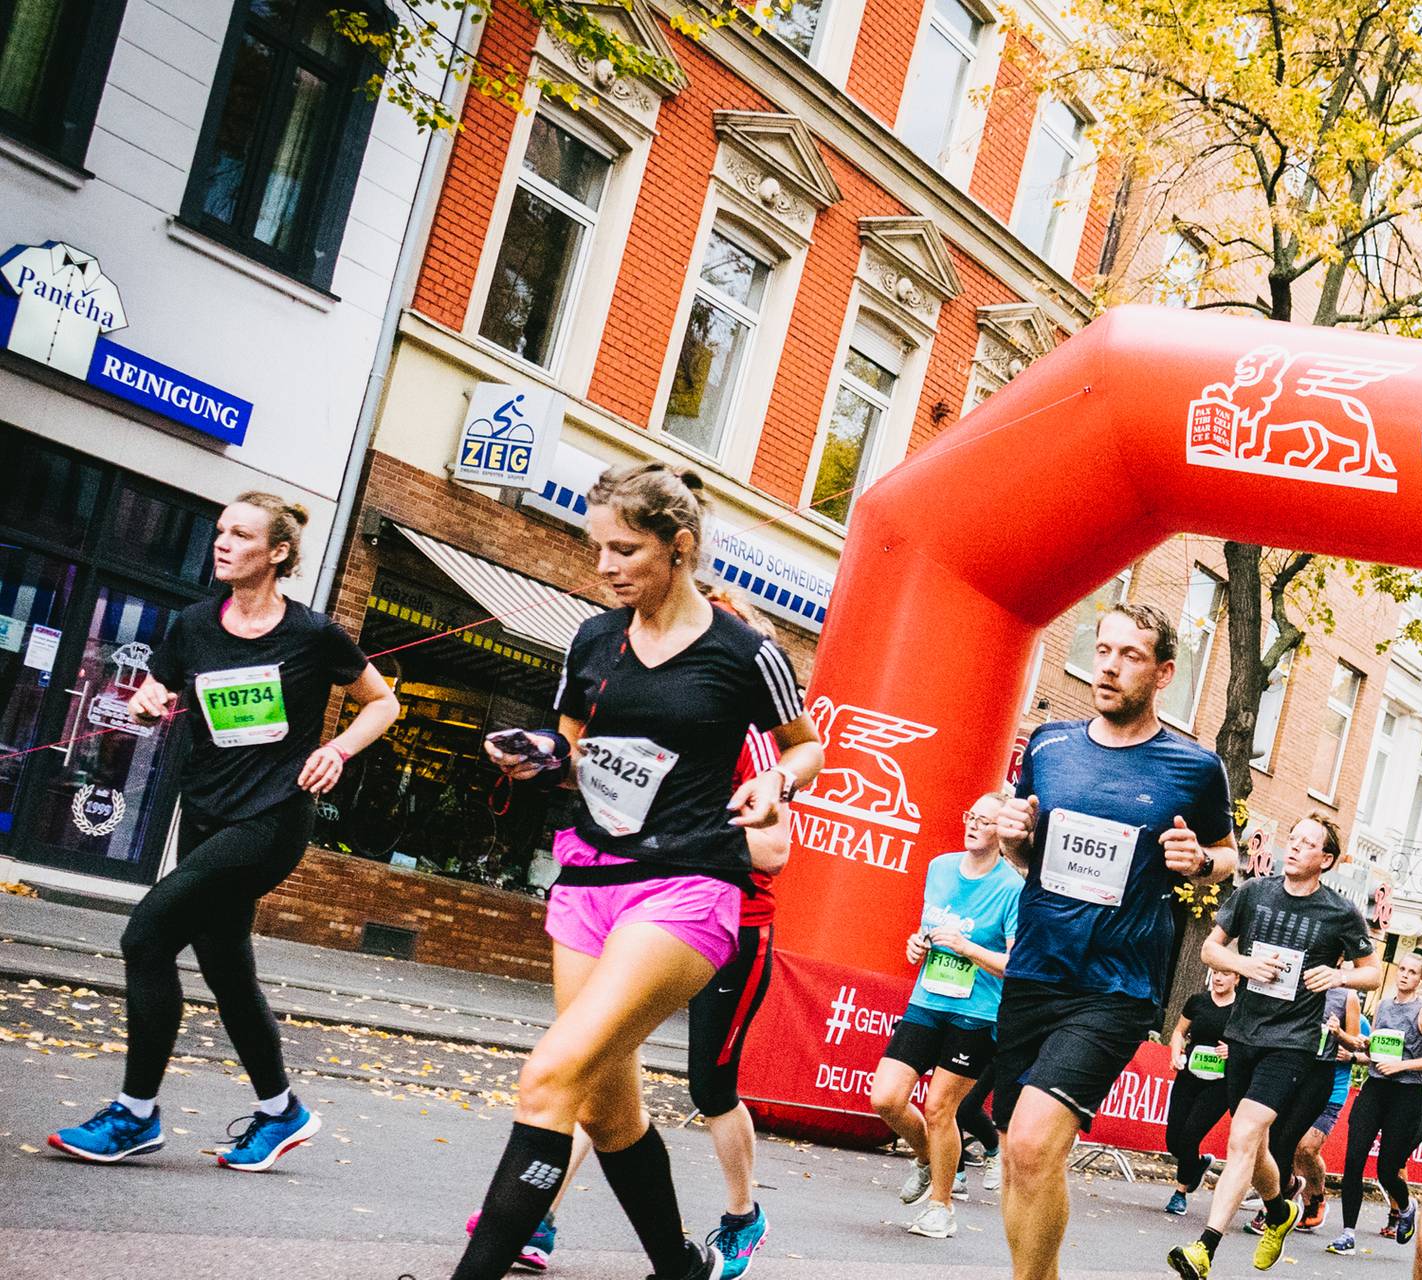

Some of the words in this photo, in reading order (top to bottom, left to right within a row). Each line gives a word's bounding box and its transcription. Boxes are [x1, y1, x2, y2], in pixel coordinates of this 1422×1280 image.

[101, 353, 240, 430] REINIGUNG
[462, 440, 529, 473] ZEG
[766, 553, 833, 601] SCHNEIDER
[208, 686, 275, 710] F19734
[590, 776, 619, 801] Nicole
[789, 809, 916, 874] NERALI
[1062, 833, 1118, 862] 15651
[1067, 861, 1101, 878] Marko
[1101, 1070, 1175, 1126] ERALI
